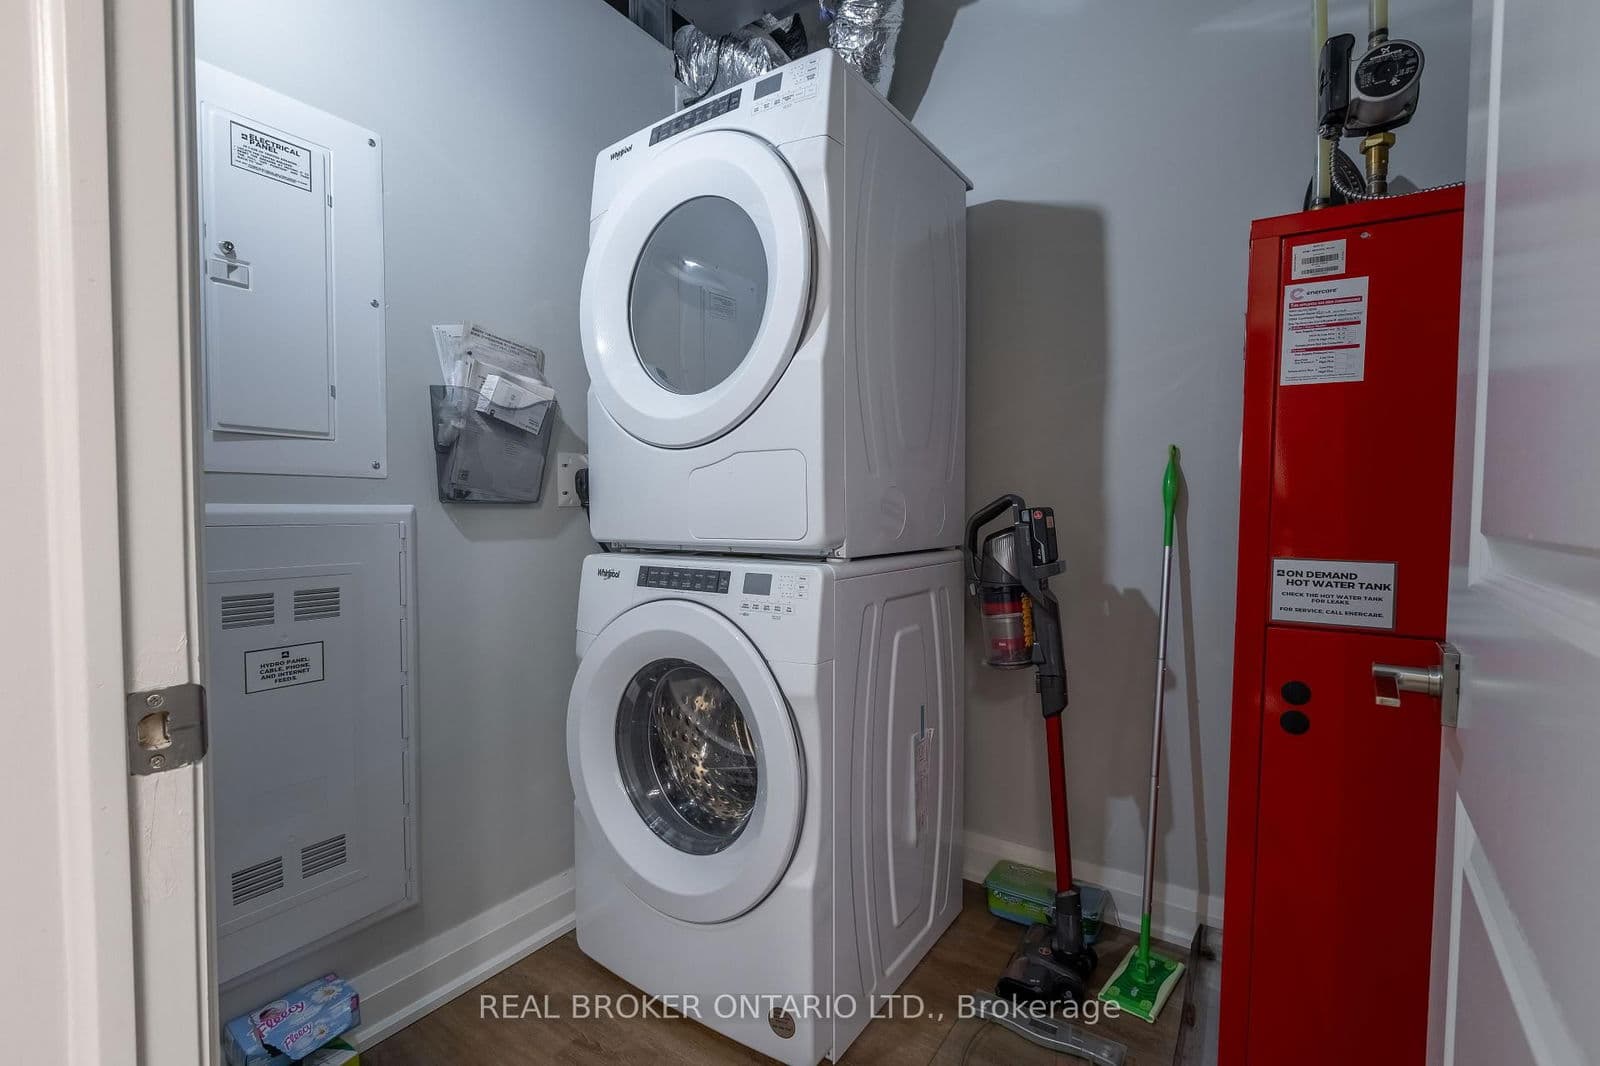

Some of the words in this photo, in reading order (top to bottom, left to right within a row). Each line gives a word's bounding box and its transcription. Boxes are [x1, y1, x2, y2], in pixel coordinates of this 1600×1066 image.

[249, 133, 301, 157] ELECTRICAL
[249, 139, 278, 154] PANEL
[597, 568, 621, 580] Whirlpool
[1286, 570, 1304, 578] ON
[1306, 571, 1358, 580] DEMAND
[1286, 579, 1310, 587] HOT
[1312, 580, 1355, 590] WATER
[1358, 582, 1392, 591] TANK
[1325, 608, 1343, 616] CALL
[260, 661, 285, 669] HYDRO
[277, 668, 310, 677] INTERNET
[284, 1023, 312, 1051] Fleecy
